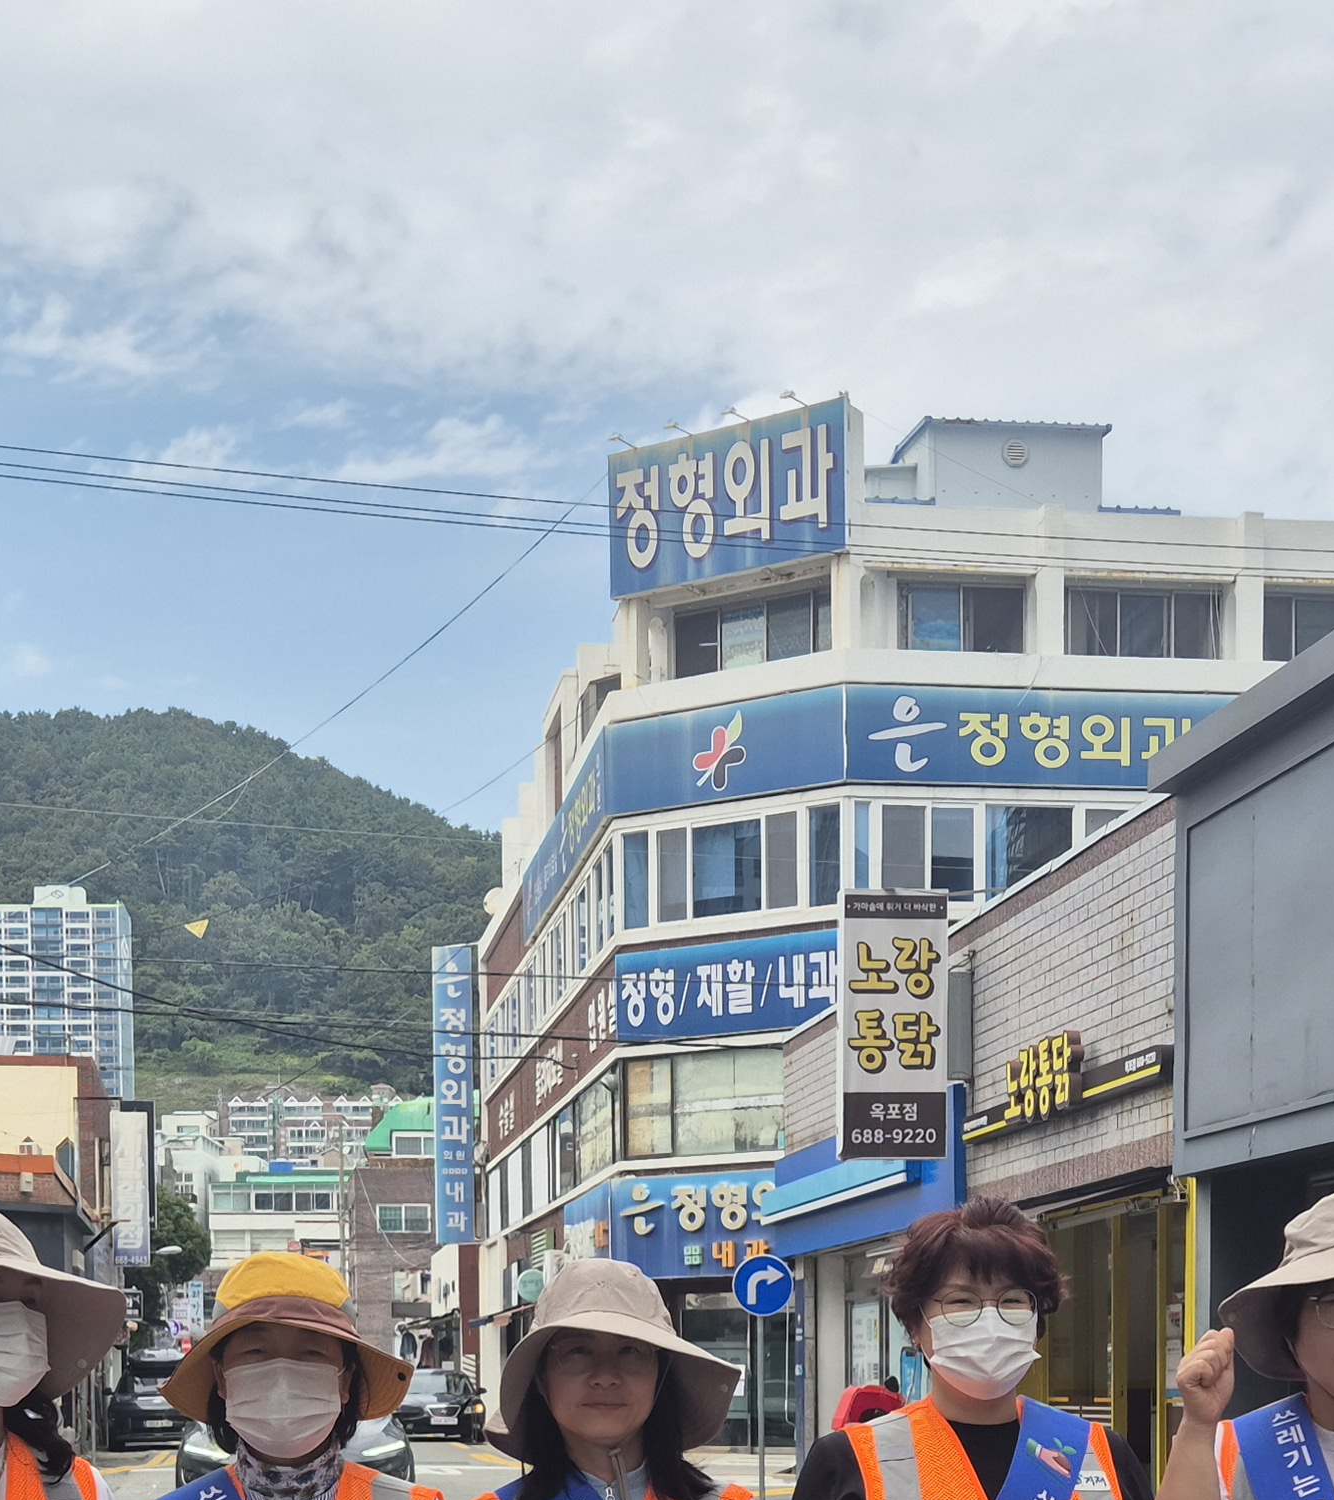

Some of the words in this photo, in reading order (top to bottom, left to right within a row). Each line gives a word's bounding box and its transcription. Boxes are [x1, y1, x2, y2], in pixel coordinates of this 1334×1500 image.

[615, 423, 835, 570] 정형외과
[867, 695, 947, 773] 은
[958, 710, 1192, 770] 정형외과
[849, 936, 941, 999] 노랑
[439, 1007, 471, 1145] 정형외과
[848, 1009, 941, 1074] 통닭
[1004, 1030, 1072, 1121] 노랑통닭
[851, 1128, 937, 1144] 688-9220
[869, 1103, 918, 1121] 옥포점
[445, 1181, 468, 1233] 내과
[1271, 1408, 1322, 1498] 쓰레기는
